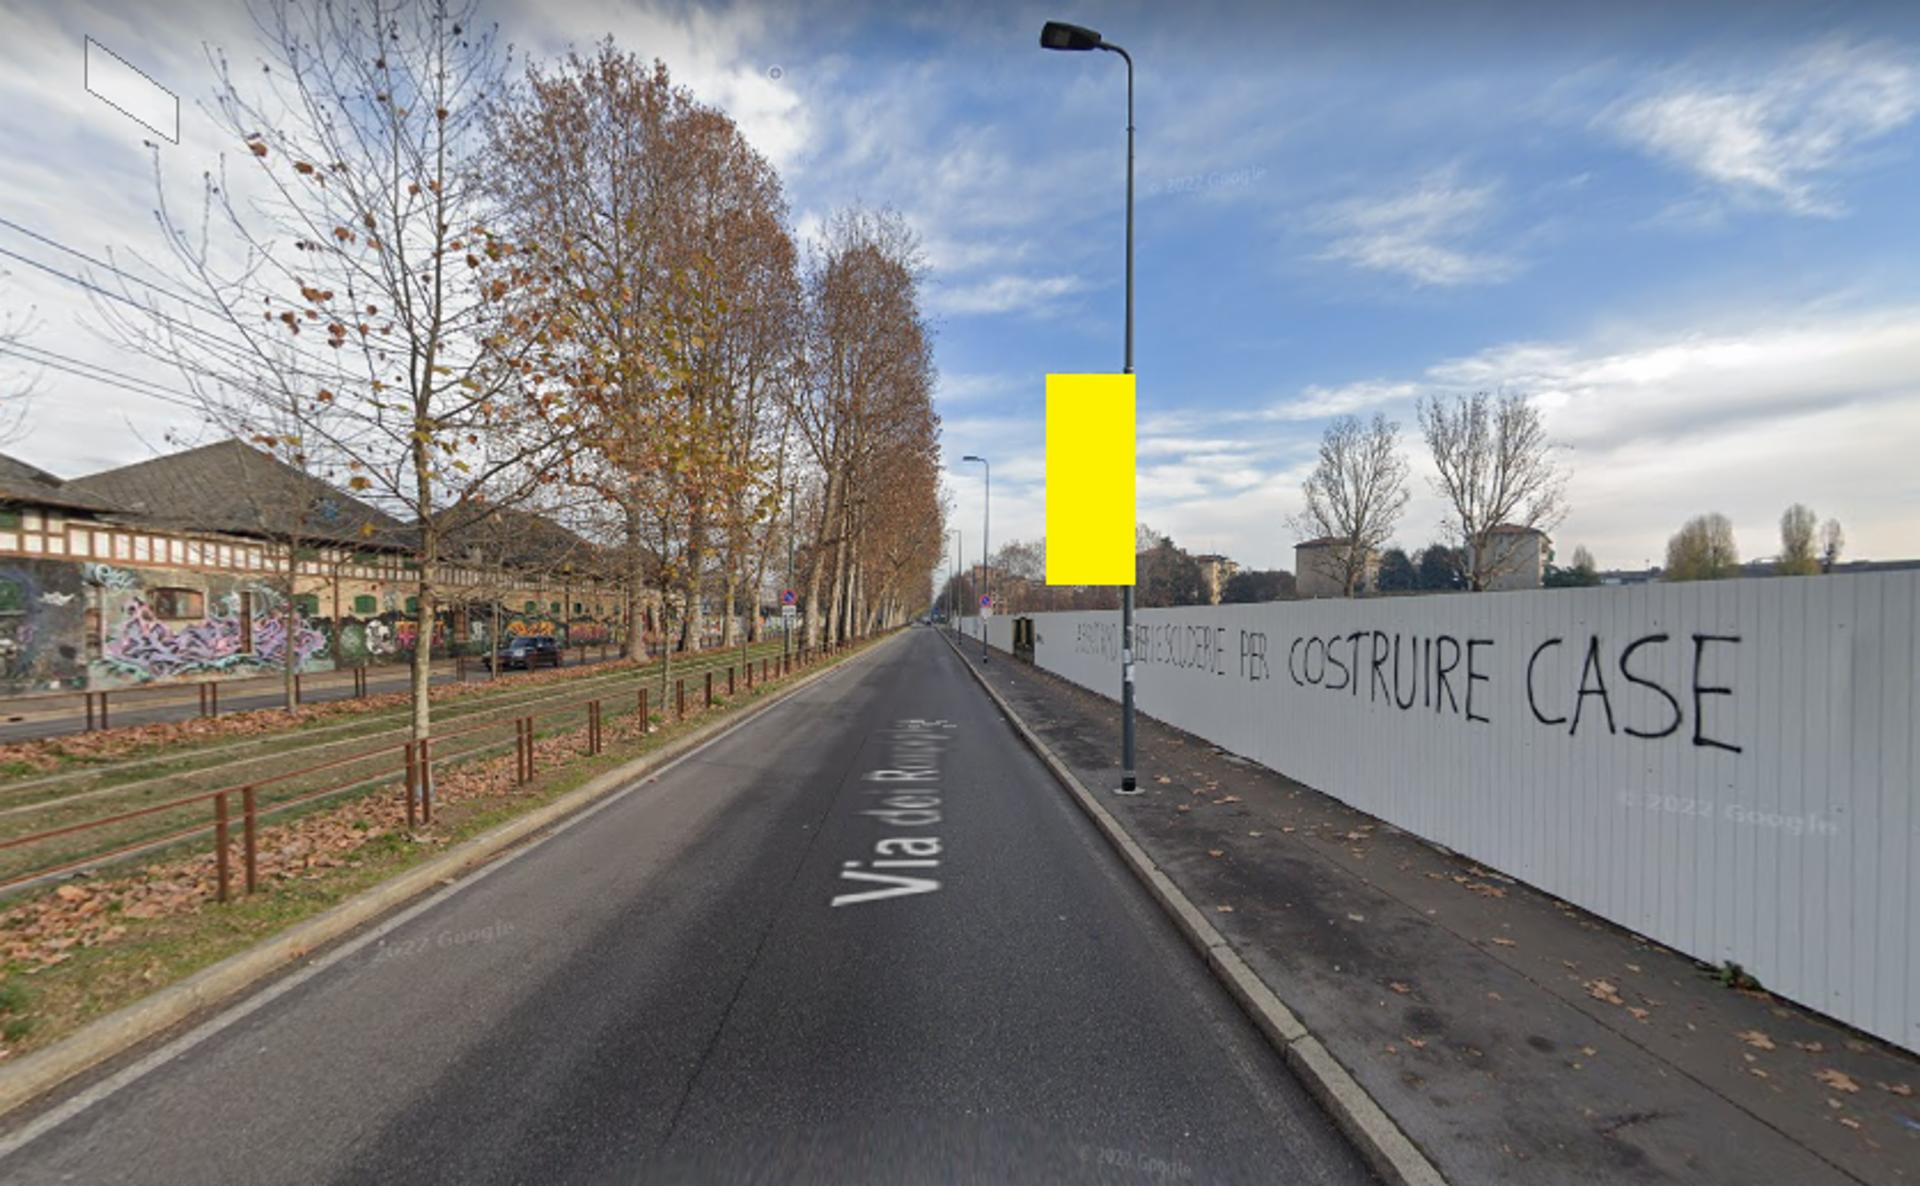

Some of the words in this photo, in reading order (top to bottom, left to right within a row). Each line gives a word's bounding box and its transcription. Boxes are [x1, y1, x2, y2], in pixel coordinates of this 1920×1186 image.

[1240, 629, 1270, 681] PER
[1288, 630, 1495, 723] COSTRUIRE
[1526, 633, 1743, 753] CASE
